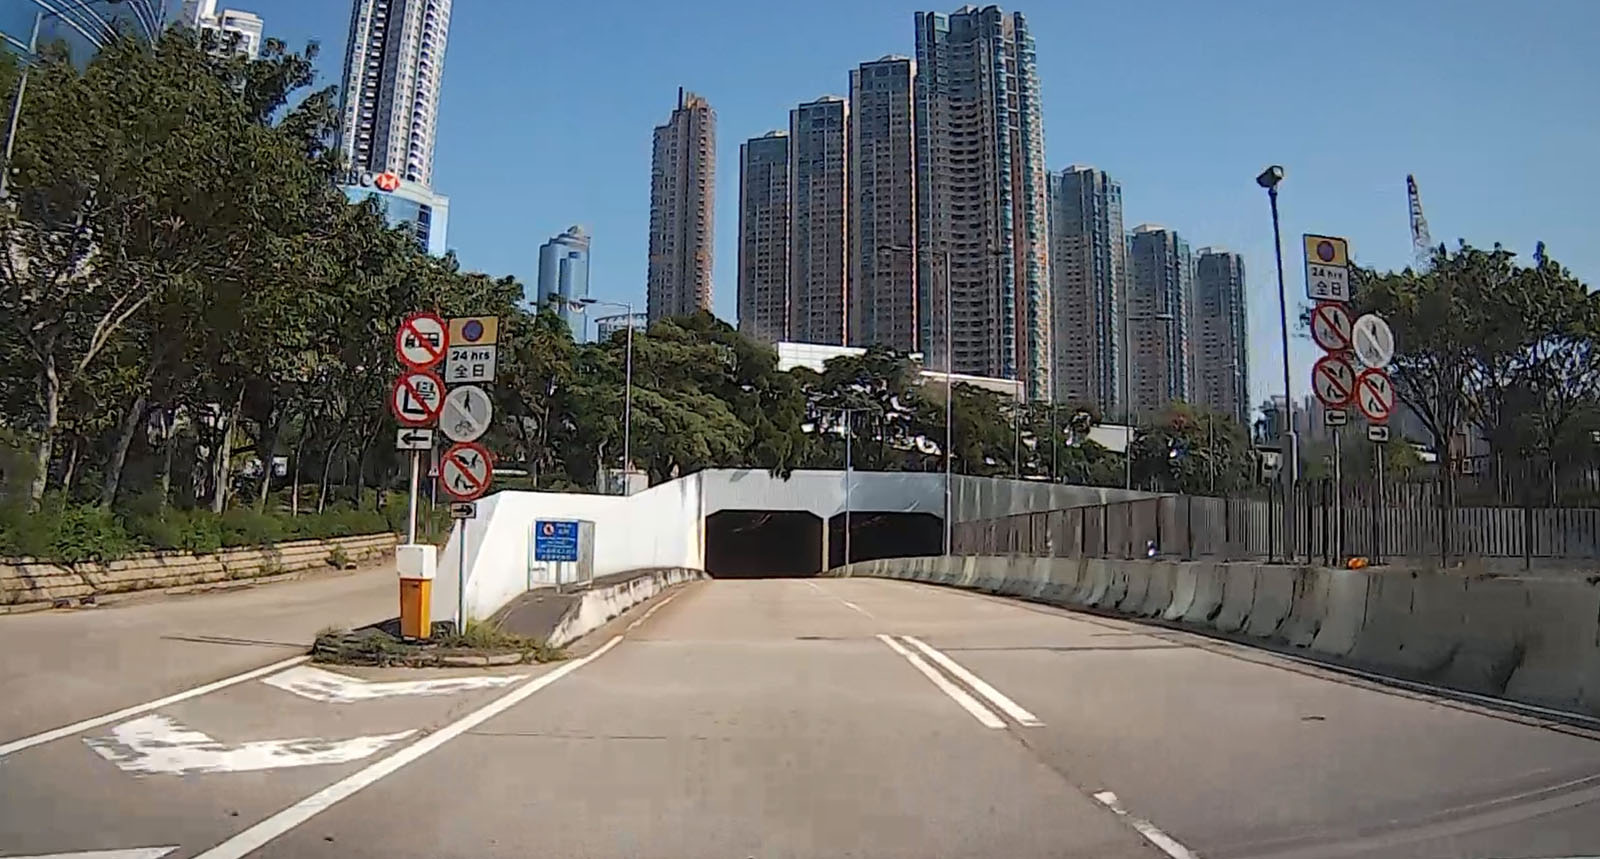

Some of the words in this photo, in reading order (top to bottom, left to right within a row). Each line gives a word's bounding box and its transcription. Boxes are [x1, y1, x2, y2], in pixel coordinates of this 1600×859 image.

[1311, 266, 1325, 277] 24
[1316, 280, 1342, 296] 全日
[452, 350, 468, 361] 24
[471, 350, 490, 361] hrs
[453, 363, 485, 379] 全日
